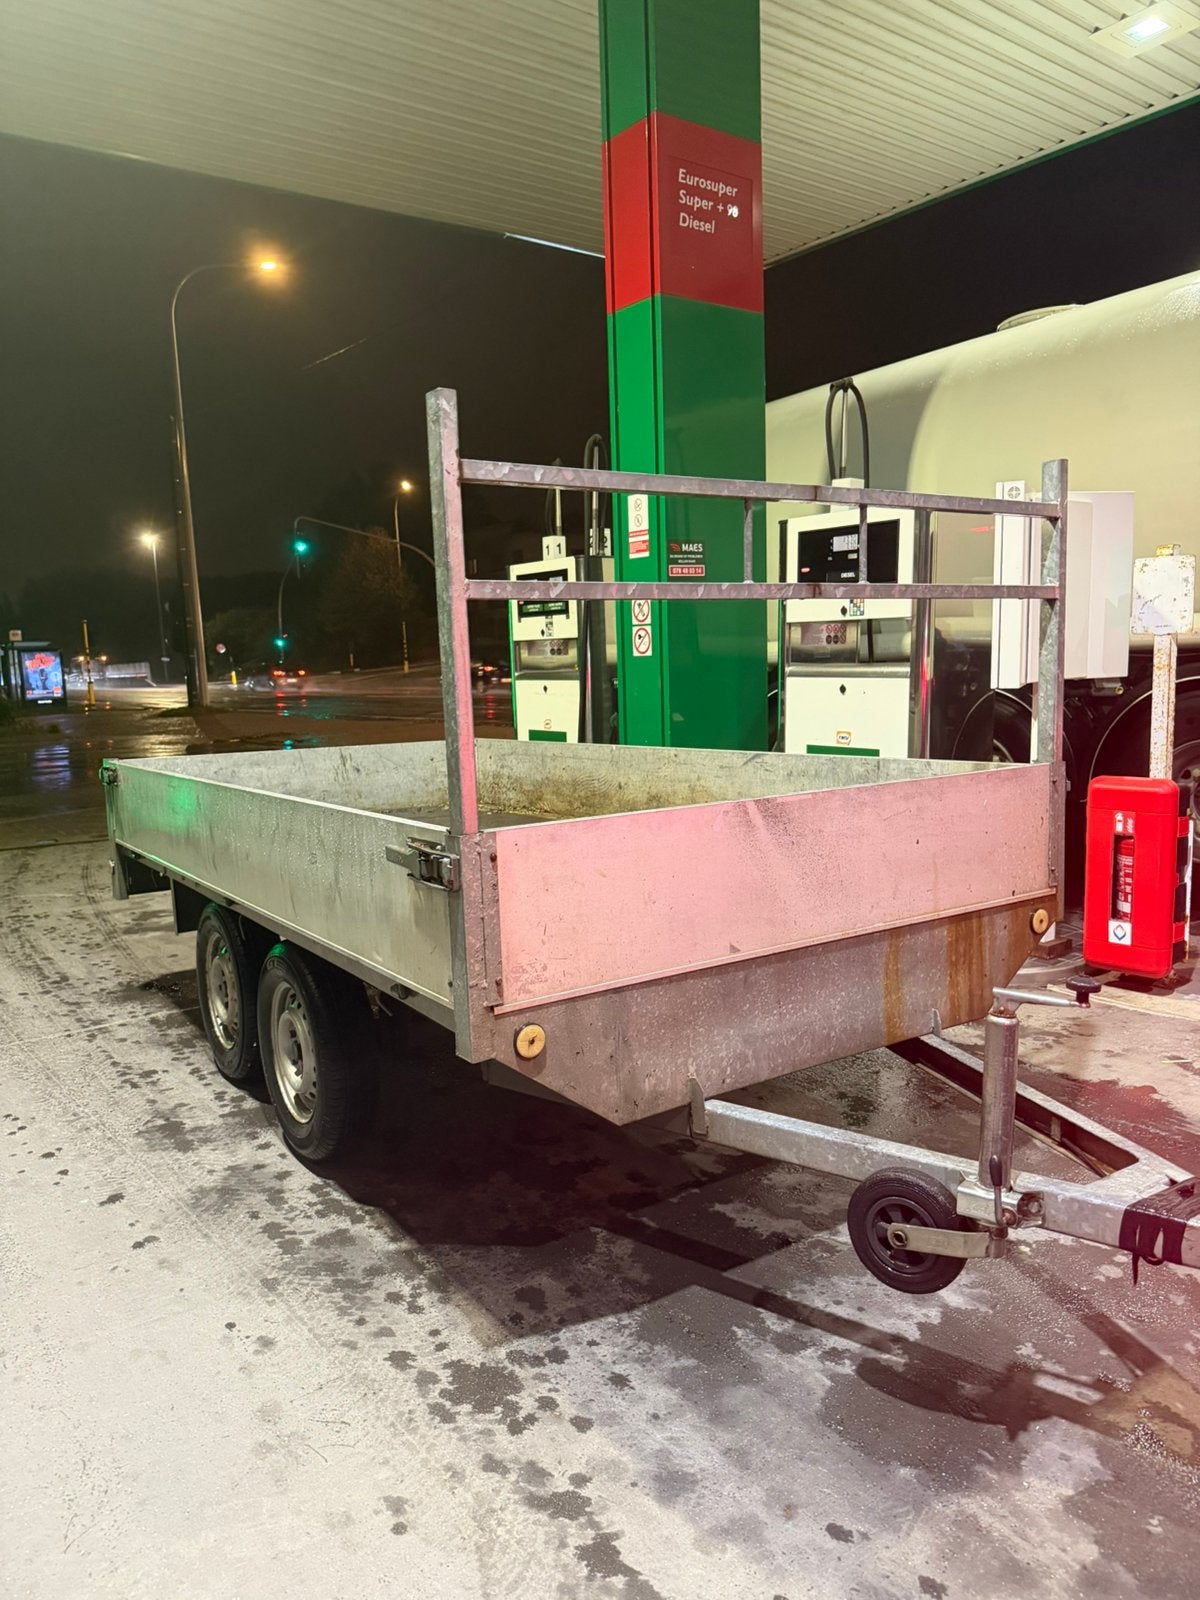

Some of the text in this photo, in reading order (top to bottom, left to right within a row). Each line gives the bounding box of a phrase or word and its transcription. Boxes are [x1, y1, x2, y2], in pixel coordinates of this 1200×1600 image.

[678, 168, 737, 197] Eurosuper
[679, 190, 714, 211] Super
[717, 204, 724, 213] +
[679, 212, 715, 233] Diesel
[545, 544, 550, 556] 1
[556, 542, 562, 555] 1
[682, 543, 704, 552] MAES
